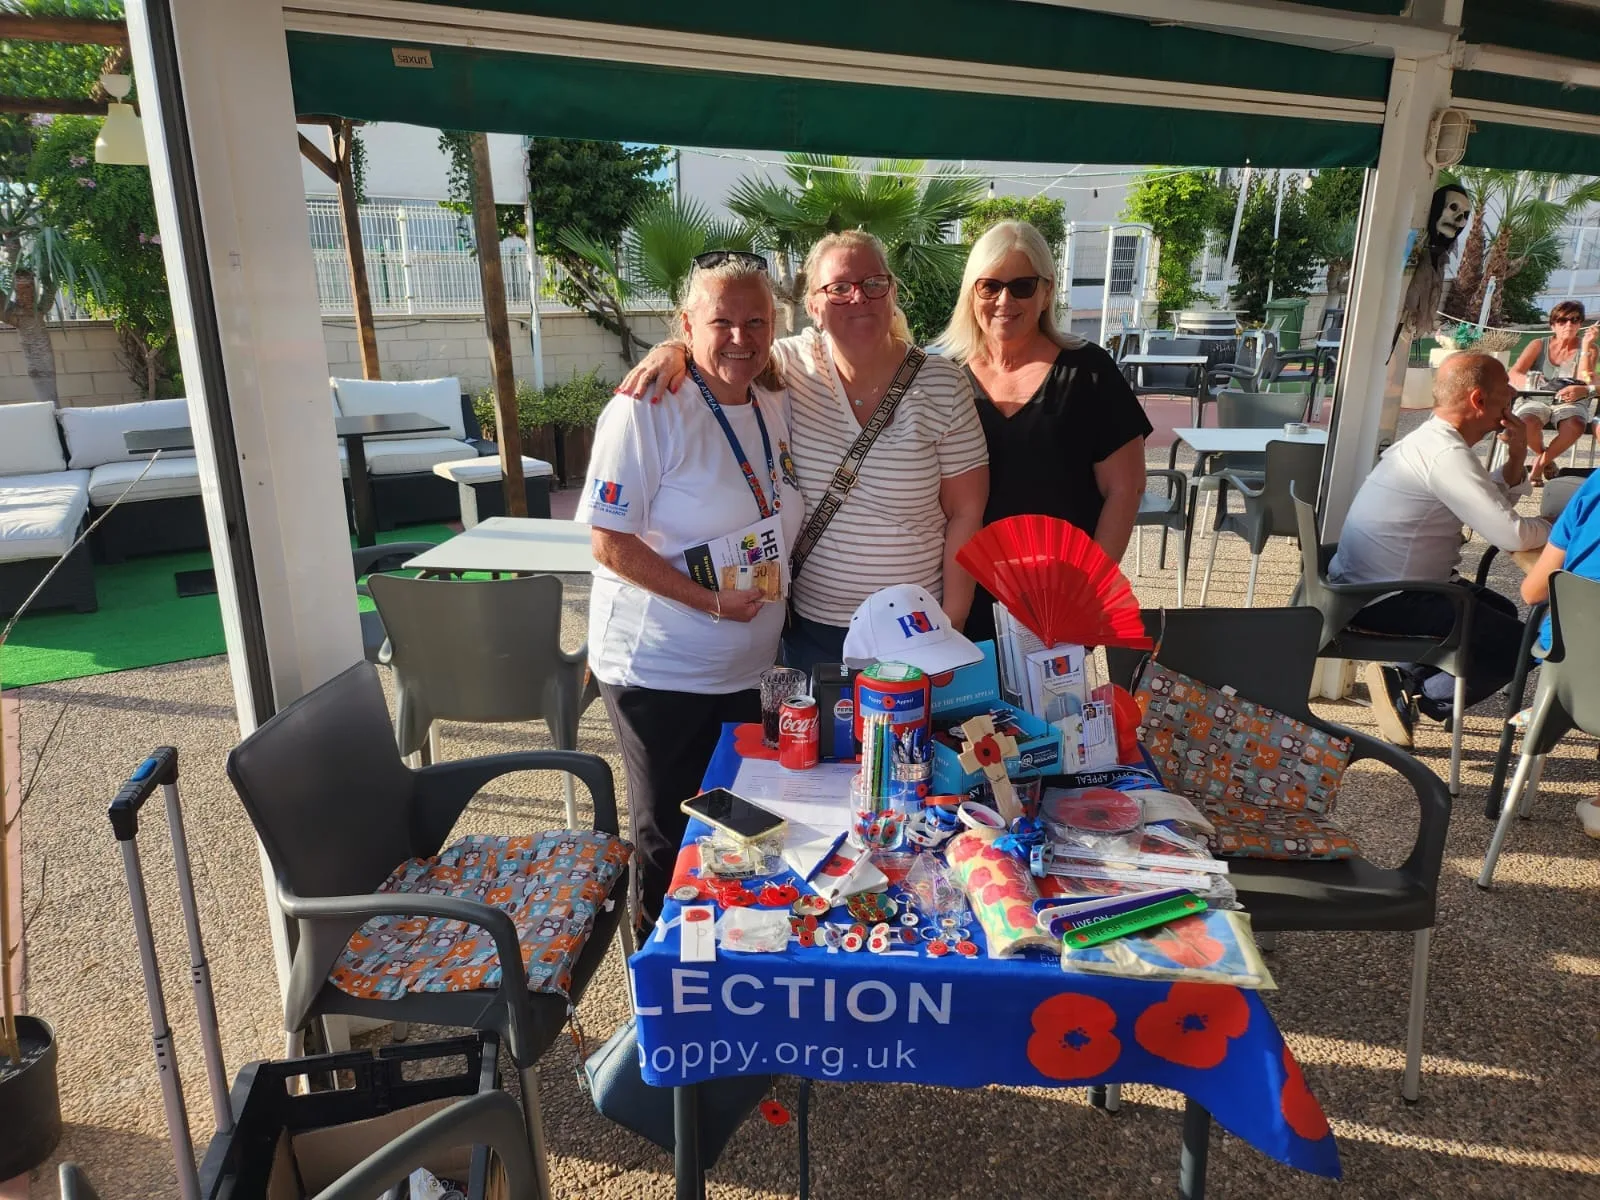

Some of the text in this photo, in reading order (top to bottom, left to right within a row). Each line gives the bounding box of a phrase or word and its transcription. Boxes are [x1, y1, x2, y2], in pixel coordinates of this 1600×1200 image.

[700, 386, 720, 412] APPEAL
[850, 381, 906, 461] RIVER ISLAND
[1075, 773, 1108, 785] APPEAL
